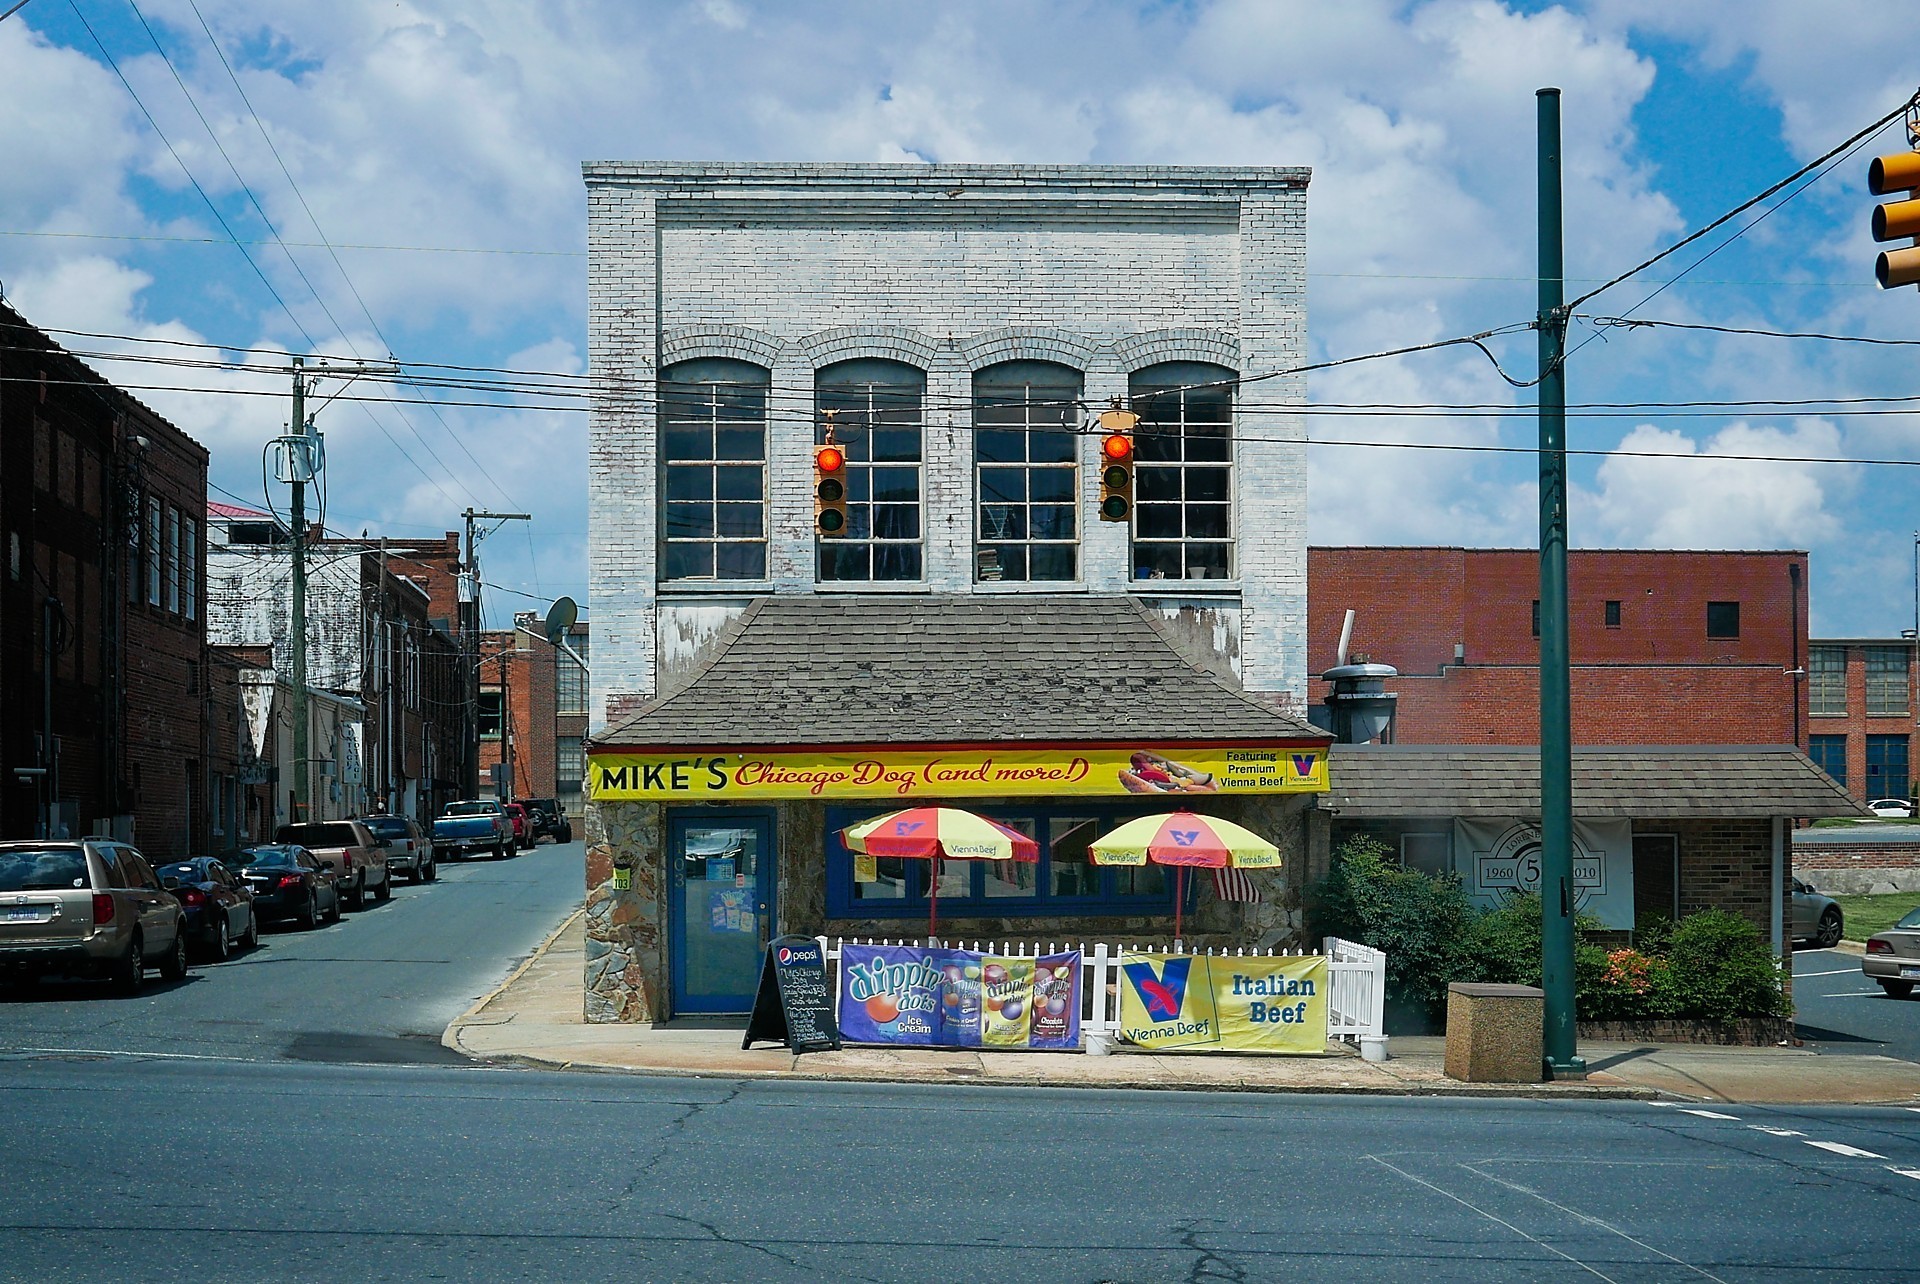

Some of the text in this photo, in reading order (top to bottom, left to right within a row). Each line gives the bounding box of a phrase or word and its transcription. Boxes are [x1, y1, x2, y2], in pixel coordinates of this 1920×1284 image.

[1226, 751, 1277, 762] Featuring
[1228, 764, 1276, 774] Premium
[602, 757, 1090, 795] MIKE'S Chicago Dog (and more!)
[1220, 776, 1284, 787] Vienna Beef
[951, 844, 997, 856] Vienna Beef
[674, 841, 685, 888] 103
[1486, 867, 1514, 878] 1960
[1574, 867, 1596, 878] 010
[614, 878, 628, 889] 103
[793, 949, 817, 962] pepsi
[848, 956, 946, 1001] dippin'
[1232, 974, 1316, 996] Italian
[896, 992, 937, 1013] dots
[1249, 1001, 1306, 1023] Beef
[907, 1015, 922, 1025] Ice
[1040, 1016, 1063, 1025] Chocolate
[897, 1022, 931, 1033] Cream
[1126, 1019, 1210, 1041] Vienna Beef
